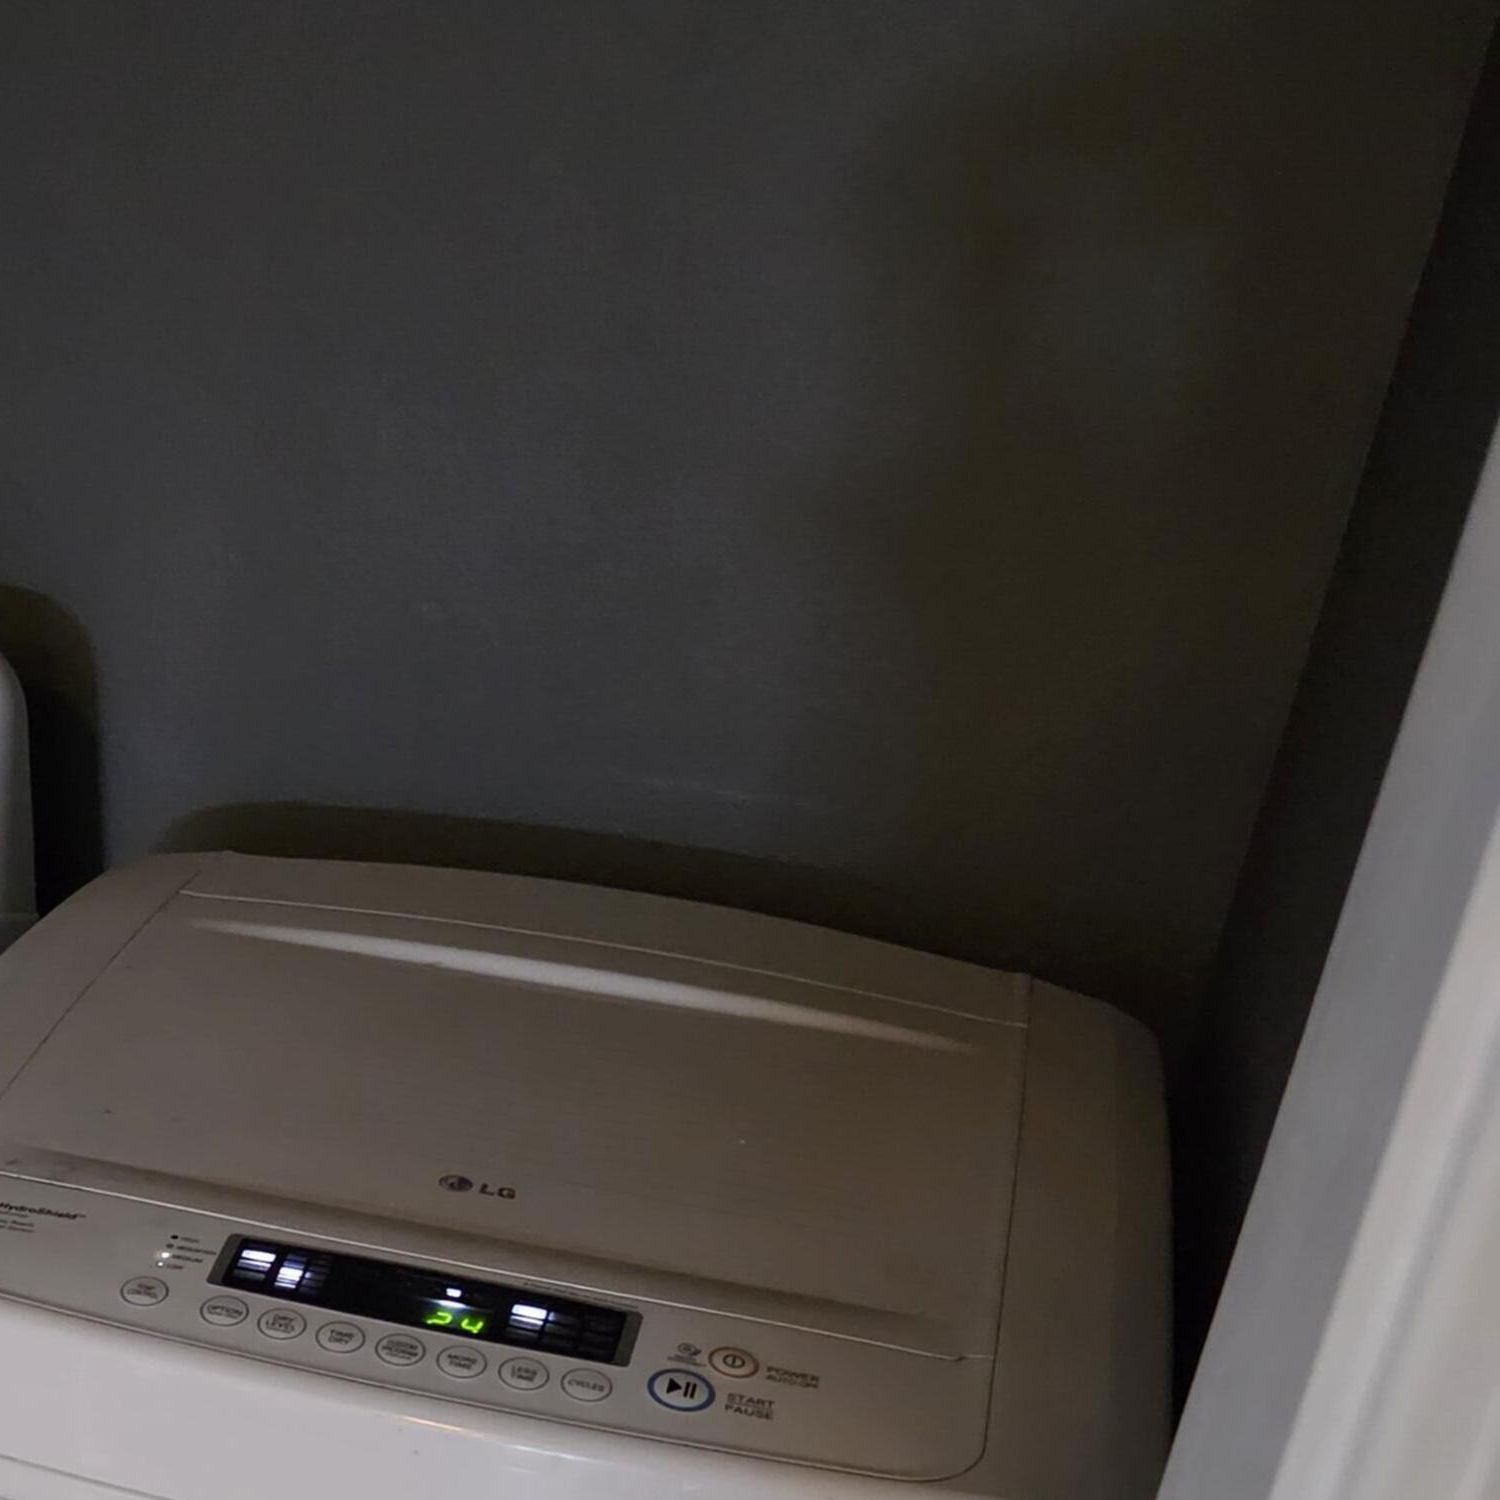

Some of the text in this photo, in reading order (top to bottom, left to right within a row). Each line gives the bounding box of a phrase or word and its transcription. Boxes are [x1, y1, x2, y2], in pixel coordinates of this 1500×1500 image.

[479, 1182, 517, 1200] LG
[426, 1311, 485, 1335] 24
[766, 1365, 820, 1383] POWER
[726, 1392, 776, 1409] START
[724, 1404, 774, 1420] PAUSE
